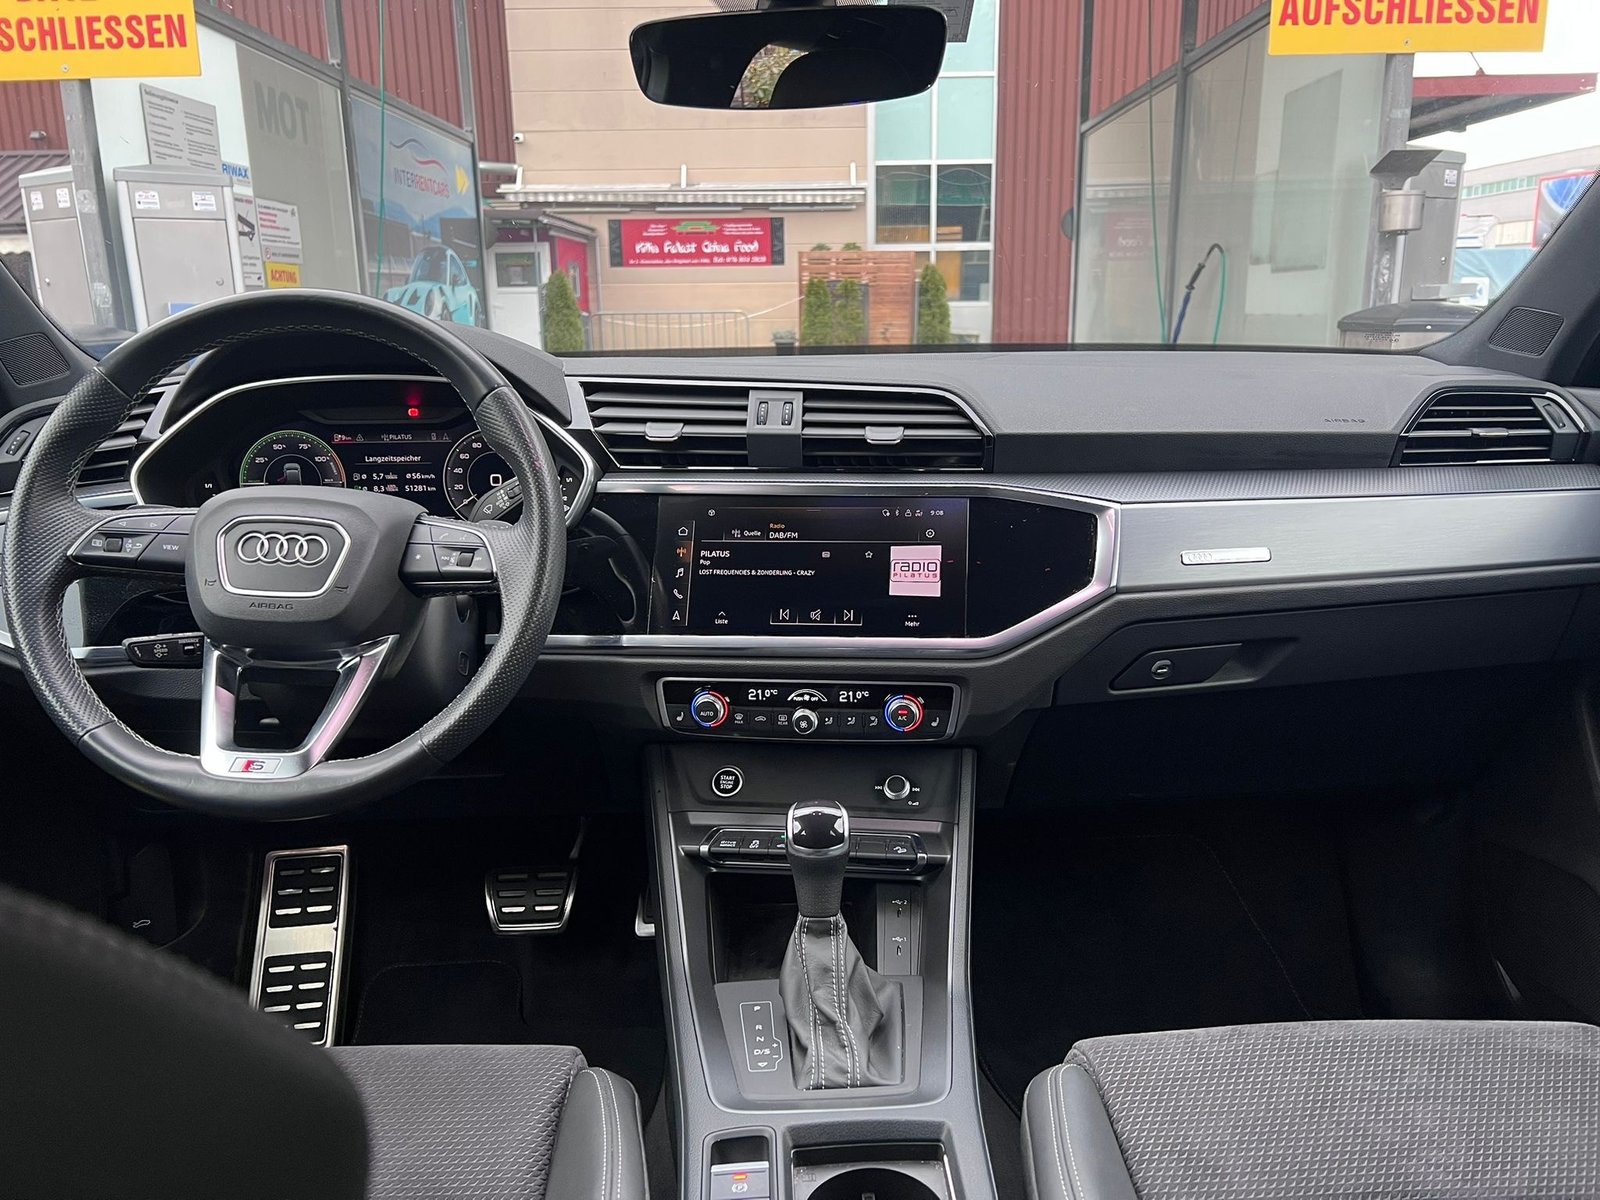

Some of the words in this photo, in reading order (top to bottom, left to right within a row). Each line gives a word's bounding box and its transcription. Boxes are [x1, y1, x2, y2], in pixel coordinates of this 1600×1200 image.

[1279, 0, 1539, 26] AUFSCHLIESSEN
[0, 14, 188, 52] SCHLIESSEN
[221, 163, 249, 179] RIWAX
[701, 240, 730, 253] China
[733, 240, 759, 253] Food
[270, 268, 298, 284] ACHTUNG
[365, 455, 421, 463] Langzeitspeicher
[769, 531, 798, 539] DAB/FM
[248, 601, 294, 610] AIRBAG
[714, 617, 728, 625] Liste
